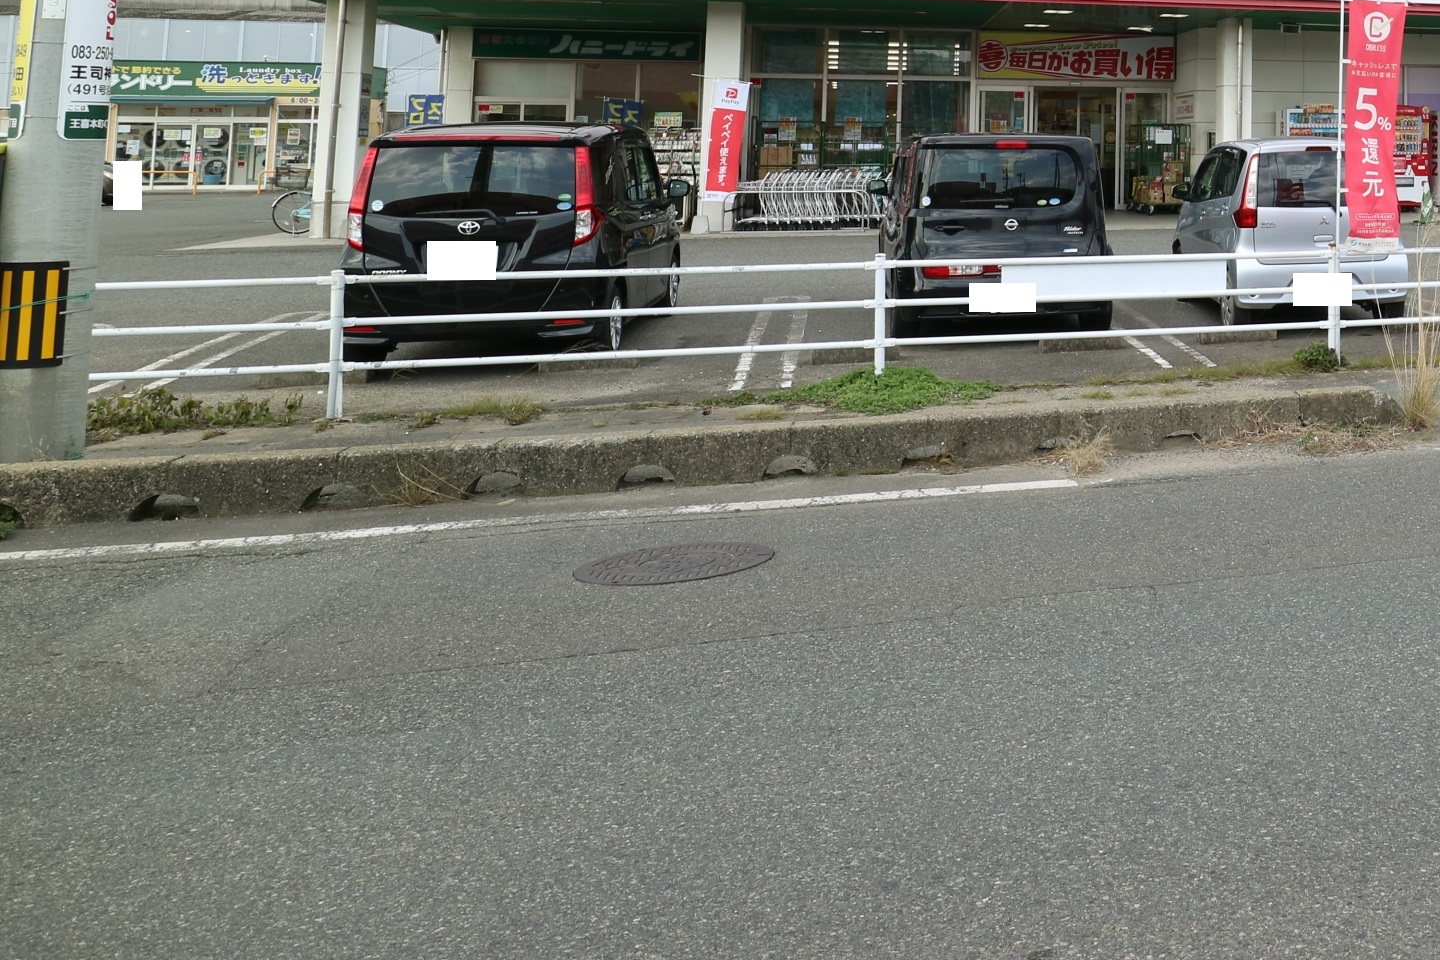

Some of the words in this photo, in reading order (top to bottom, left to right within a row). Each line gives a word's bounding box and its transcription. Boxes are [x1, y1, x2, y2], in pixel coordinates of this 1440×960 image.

[549, 34, 694, 57] ハニードライ
[1057, 42, 1082, 50] Low
[1366, 43, 1386, 52] CASHLESS
[1009, 47, 1174, 80] 毎日がお買い得
[1352, 60, 1397, 70] キャッシュレスで
[1354, 87, 1391, 130] 5%
[718, 113, 734, 186] ペイペイ使えます。
[1361, 137, 1384, 197] 還元
